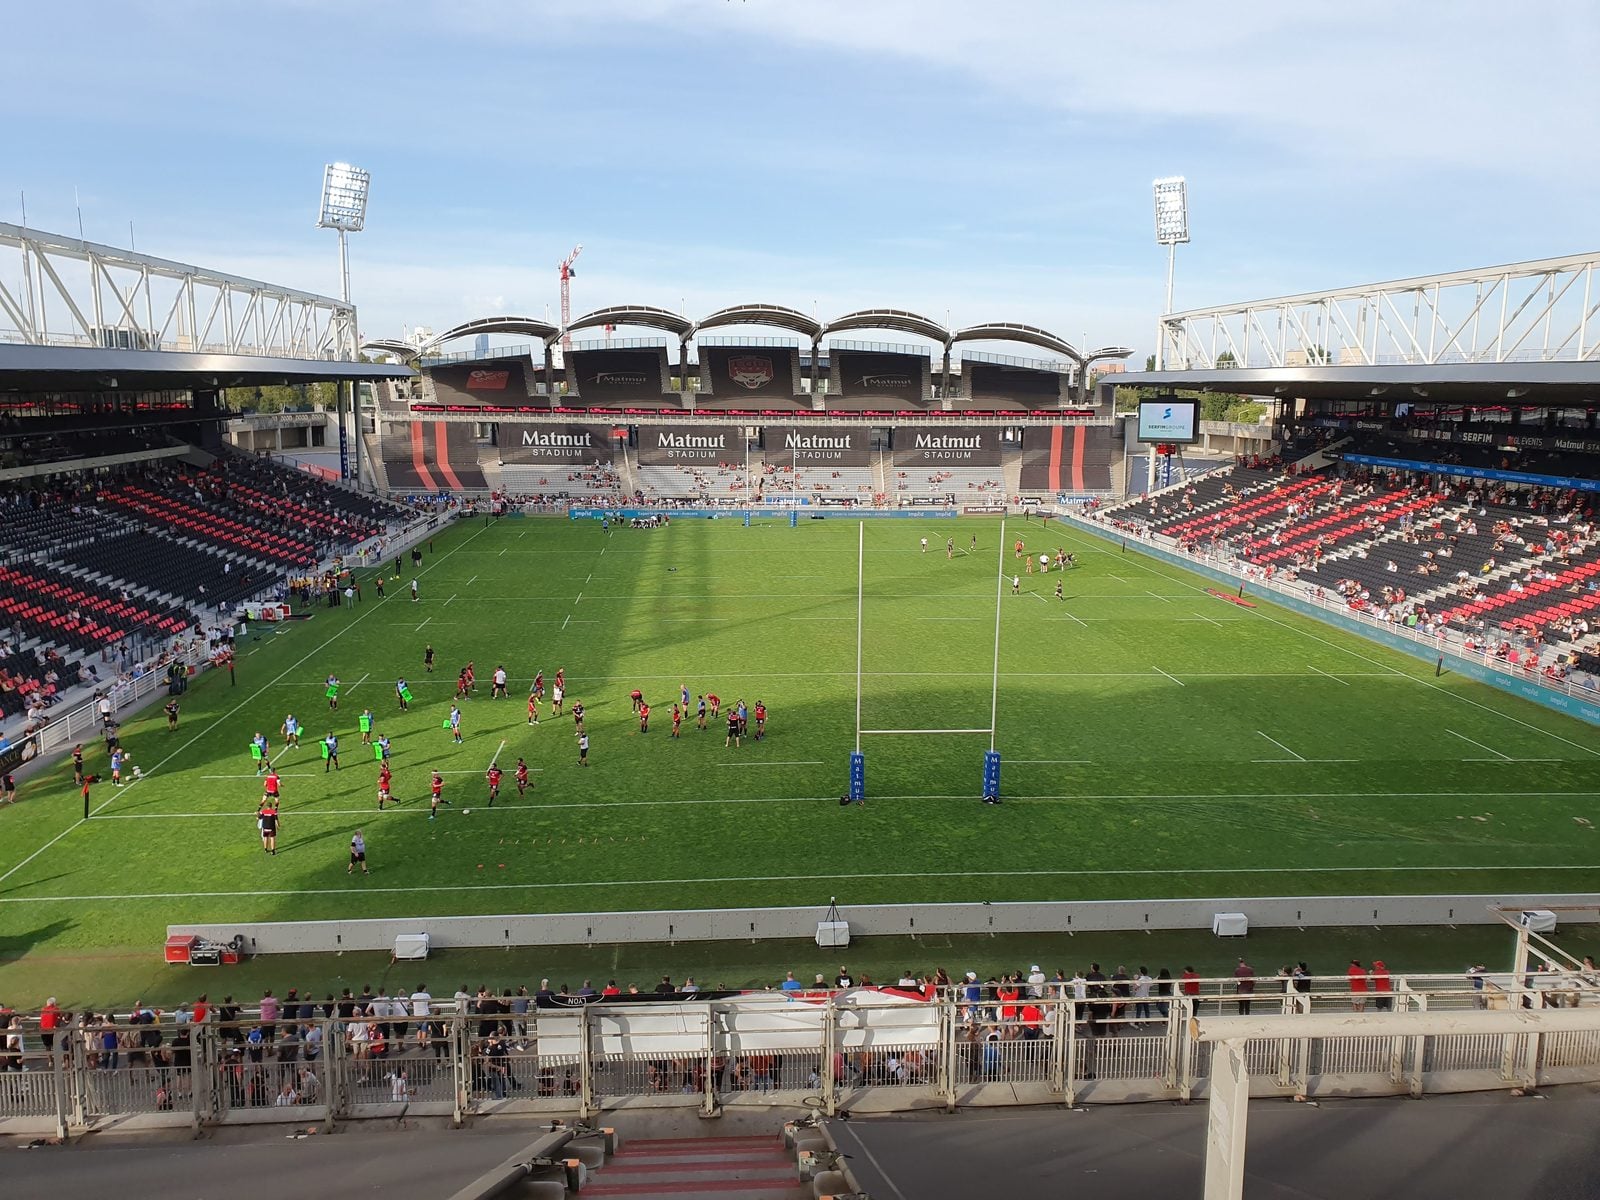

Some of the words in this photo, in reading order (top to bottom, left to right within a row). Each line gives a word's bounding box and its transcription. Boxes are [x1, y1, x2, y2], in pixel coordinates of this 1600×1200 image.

[522, 430, 592, 446] Matmut
[658, 432, 726, 448] Matmut
[785, 433, 851, 448] Matmut
[915, 433, 982, 448] Matmut
[1463, 432, 1493, 443] SERFIM
[1521, 437, 1543, 446] EVENTS
[1554, 439, 1585, 450] Matmut
[668, 450, 716, 458] STADIUM
[854, 758, 862, 800] Matmut
[568, 997, 587, 1005] LYON
